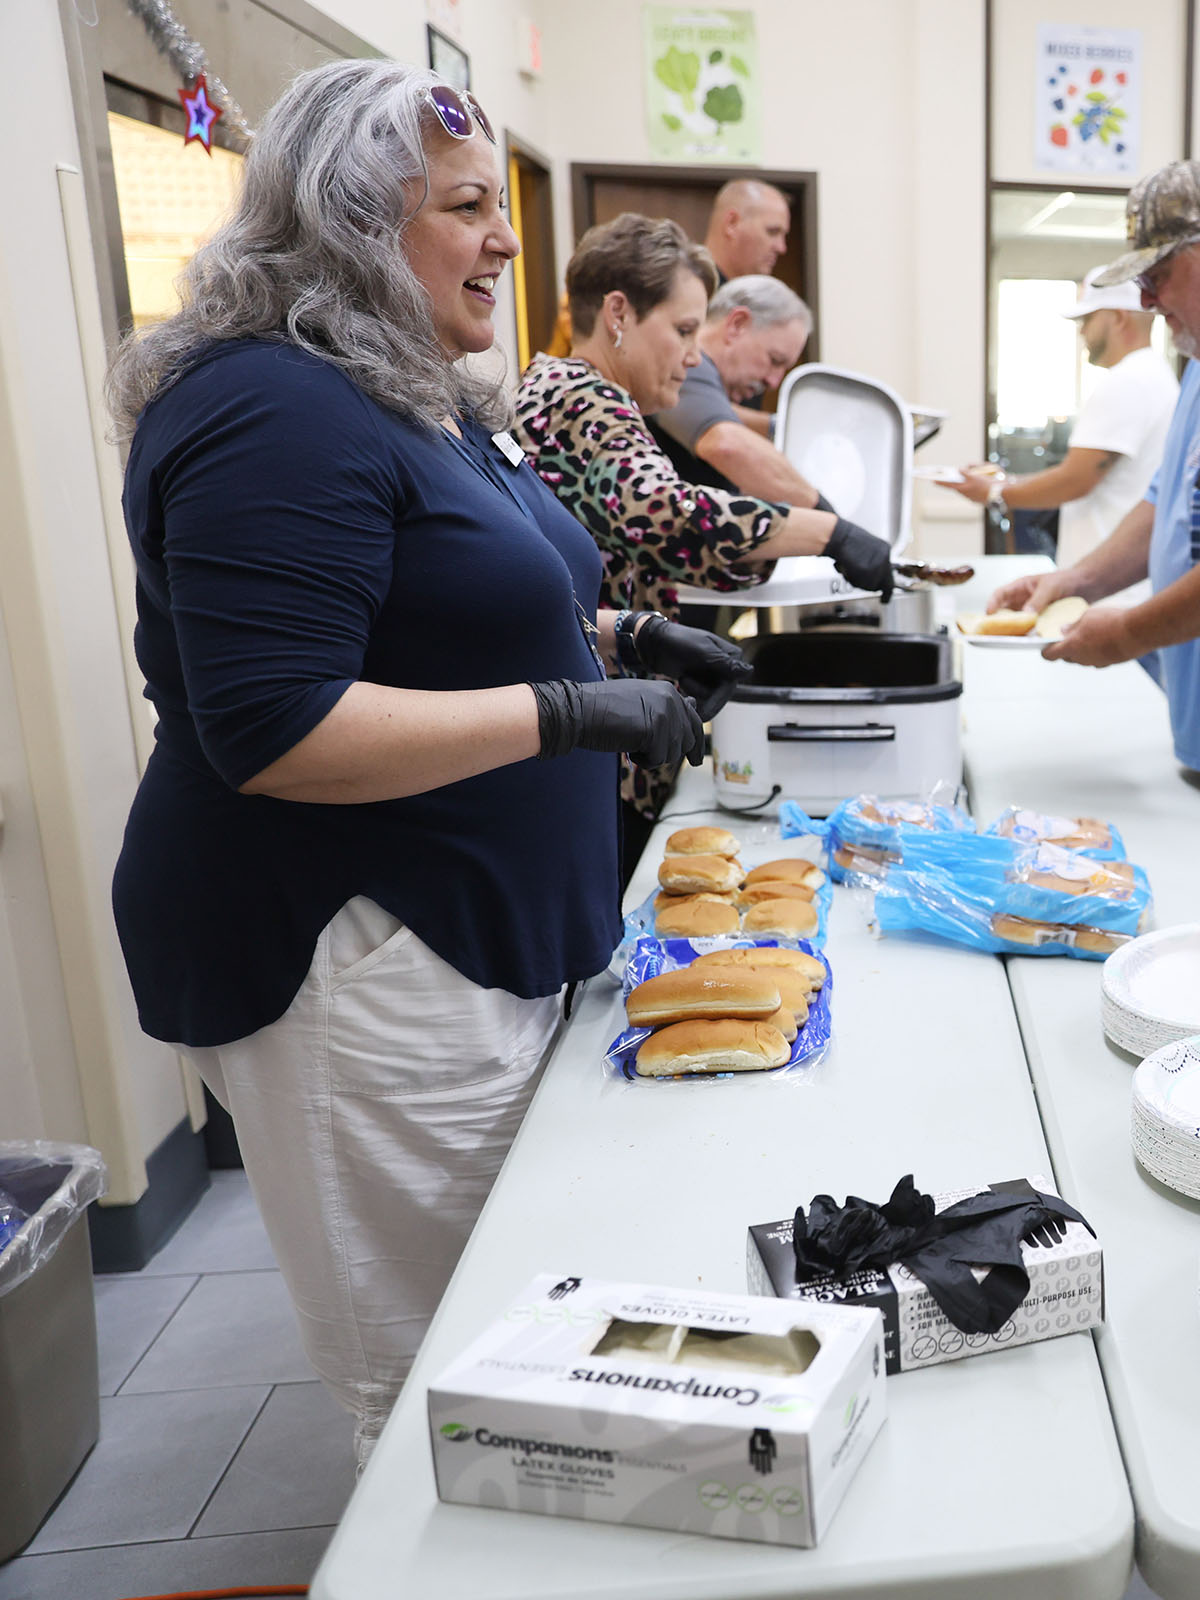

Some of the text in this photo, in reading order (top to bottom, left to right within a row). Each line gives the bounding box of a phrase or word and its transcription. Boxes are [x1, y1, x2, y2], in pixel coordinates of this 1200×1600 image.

[568, 1367, 761, 1407] Companions
[474, 1427, 615, 1464] Companions
[511, 1455, 554, 1471] LATEX
[558, 1461, 616, 1480] GLOVES
